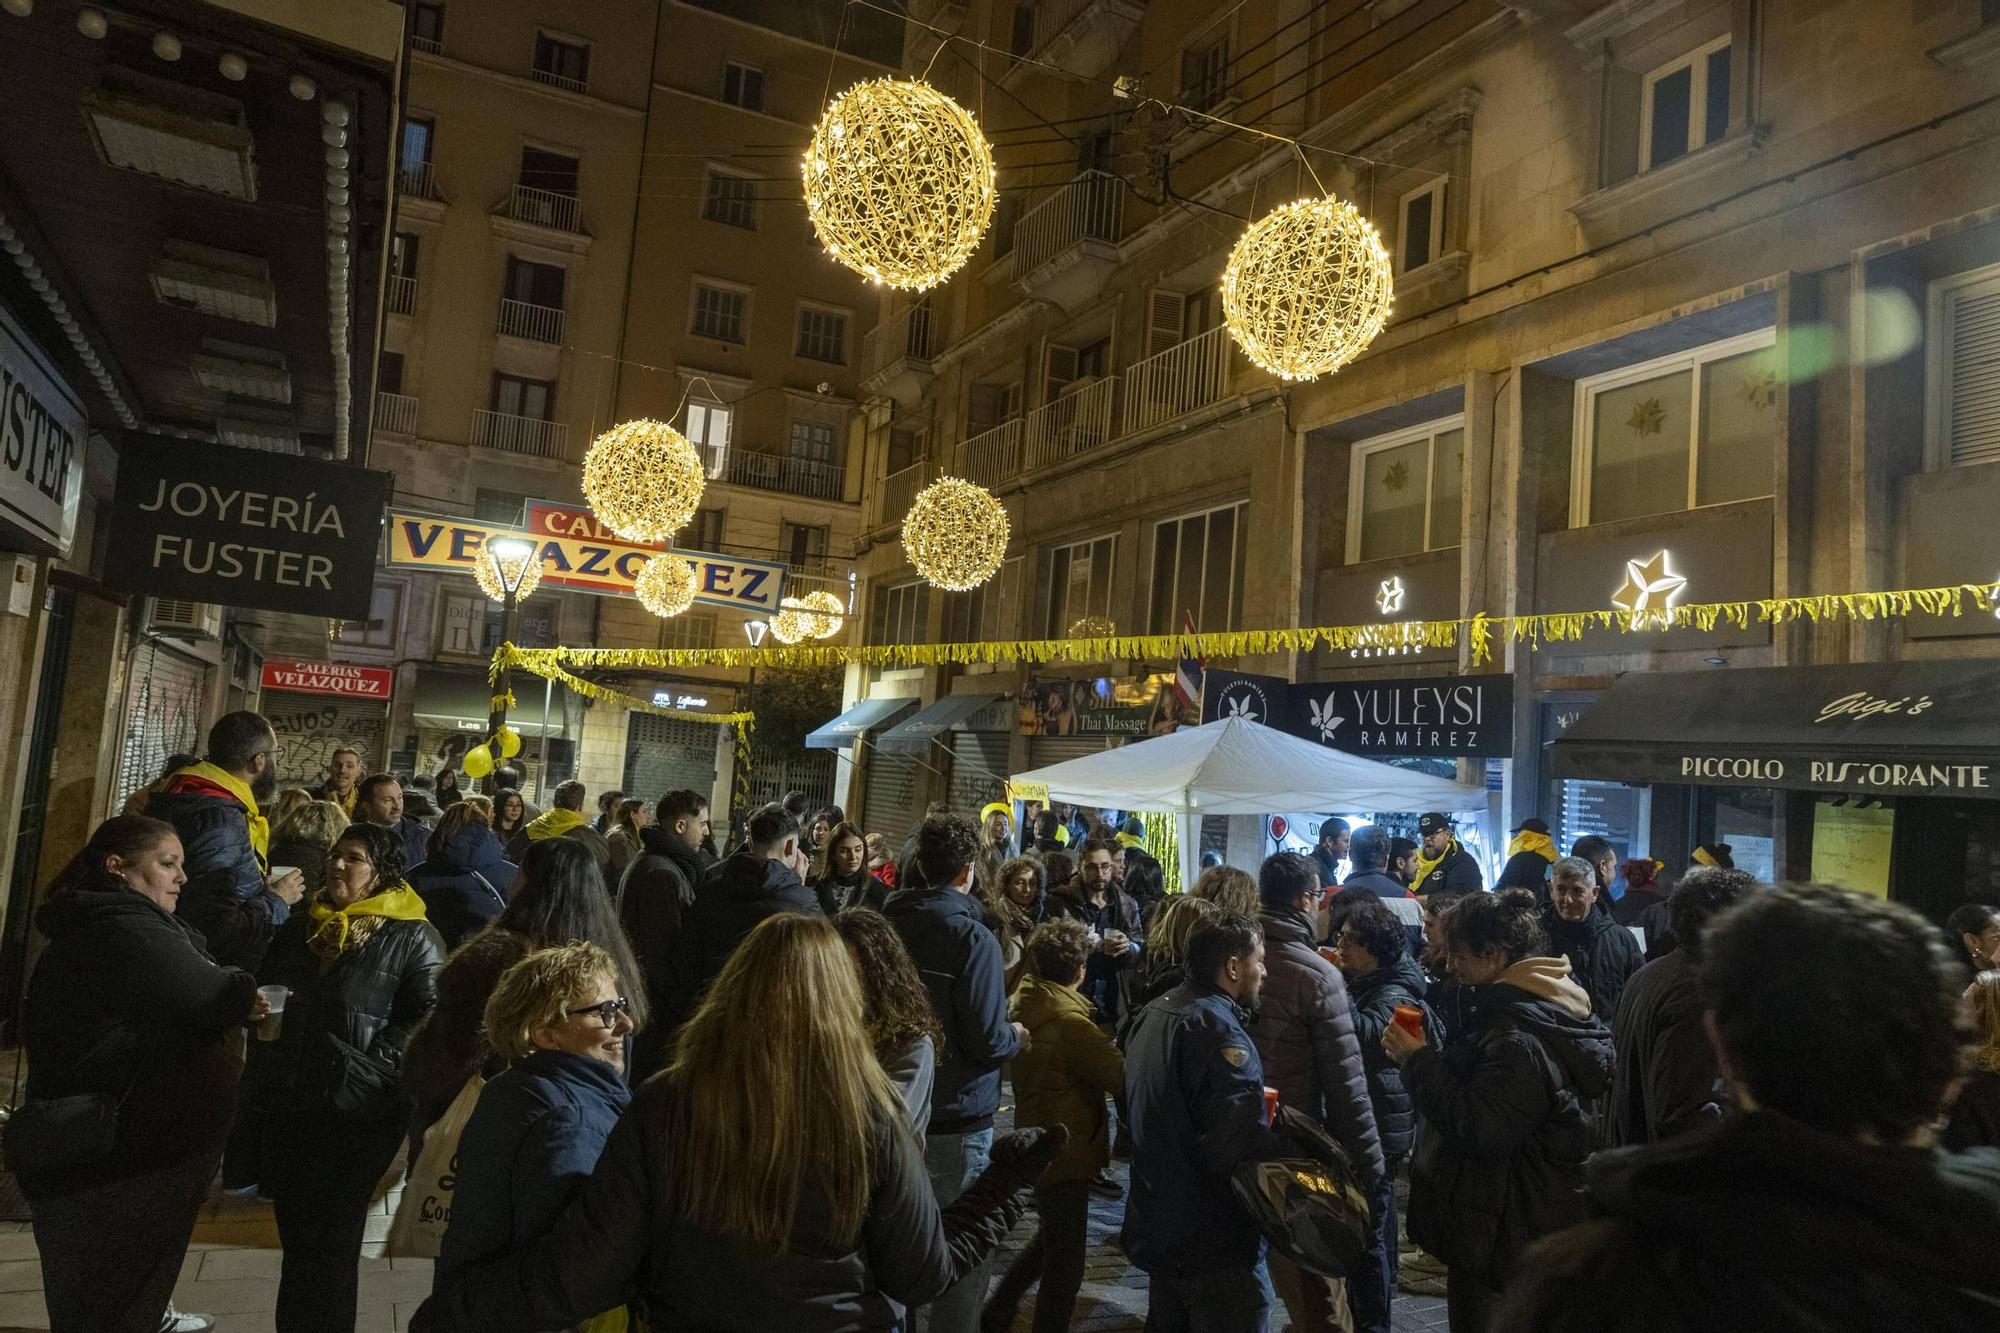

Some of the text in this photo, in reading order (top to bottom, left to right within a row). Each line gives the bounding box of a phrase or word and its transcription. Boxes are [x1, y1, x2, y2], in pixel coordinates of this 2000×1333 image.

[138, 478, 346, 538] JOYERÍA
[544, 511, 654, 546] CAL
[152, 534, 334, 591] FUSTER
[402, 520, 771, 603] VEAZQEZ
[273, 670, 381, 693] VELAZQUEZ
[1353, 685, 1482, 726] YULEYSI
[1814, 691, 1934, 723] Gigi's
[1080, 713, 1147, 734] Thai Massage
[1361, 727, 1477, 747] RAMÍREZ
[1681, 757, 1784, 780] PICCOLO
